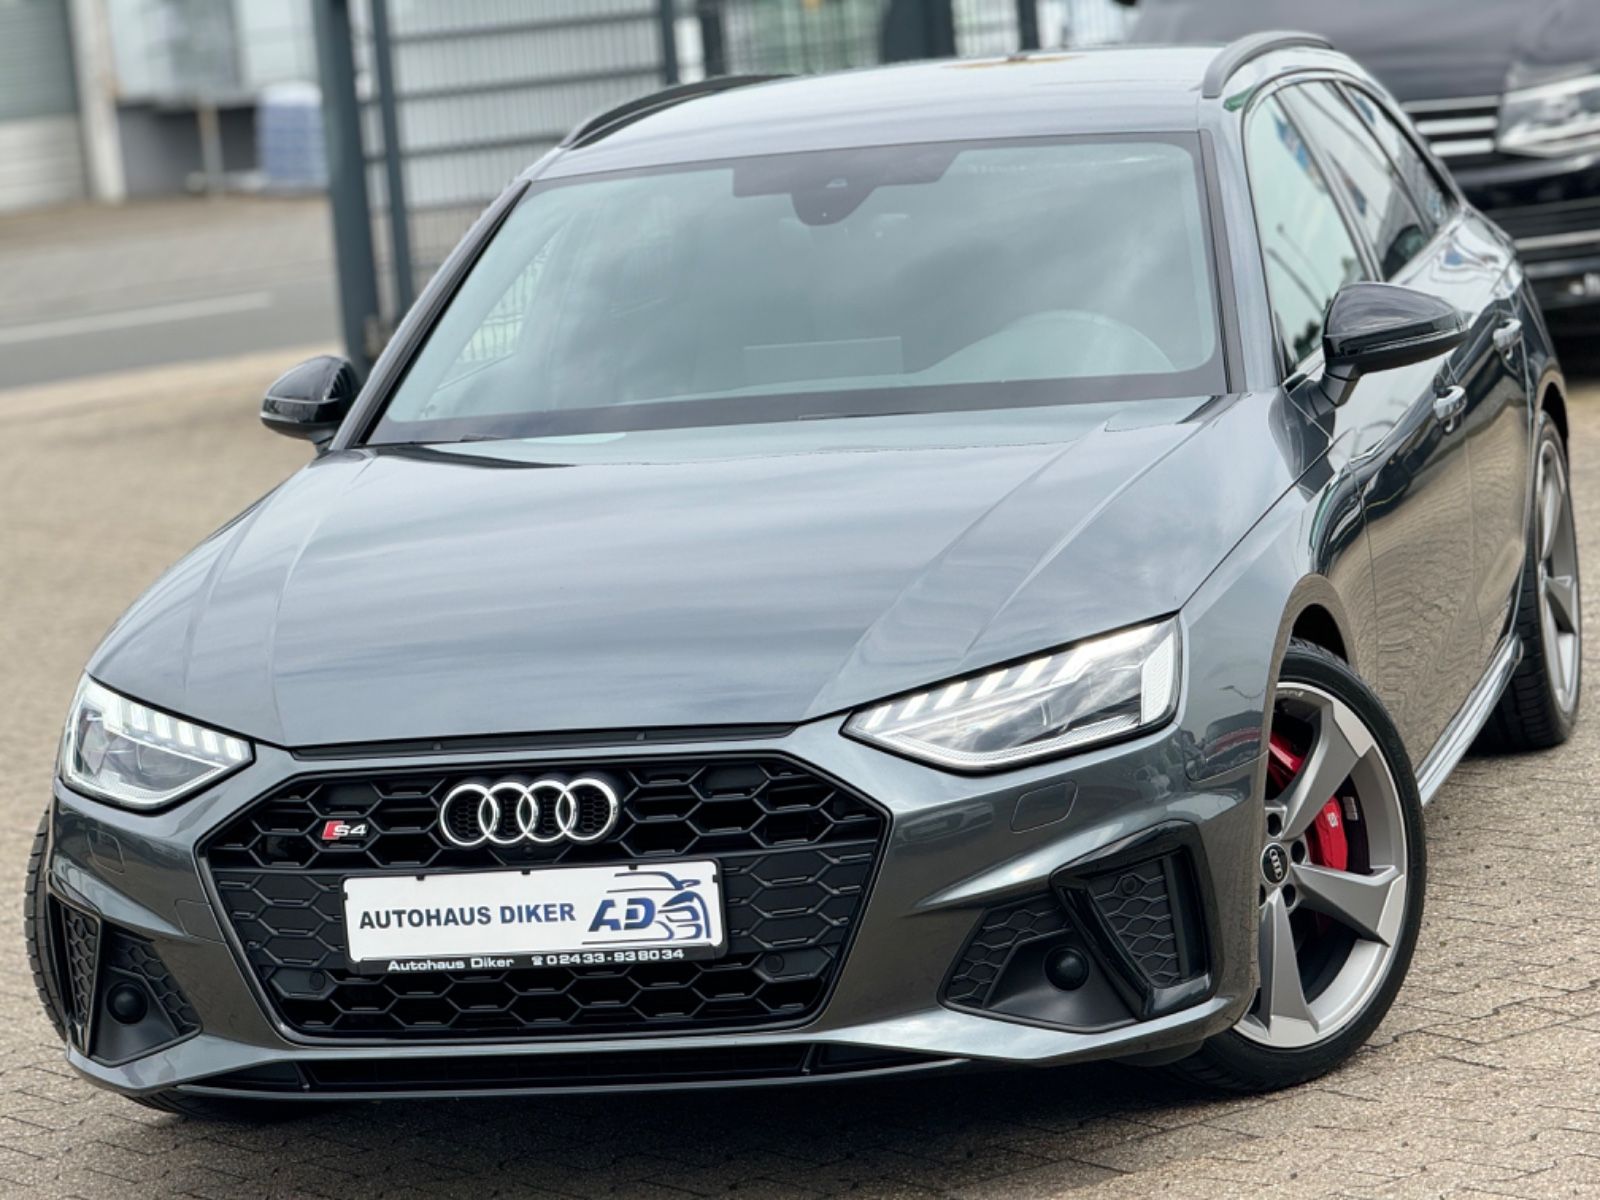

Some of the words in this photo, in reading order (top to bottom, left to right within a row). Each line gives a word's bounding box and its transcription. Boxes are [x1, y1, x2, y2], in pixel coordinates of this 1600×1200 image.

[332, 823, 367, 837] S4
[359, 906, 492, 930] AUTOHAUS
[500, 902, 576, 924] DIKER
[588, 897, 656, 932] AD
[387, 959, 465, 972] Autohaus
[470, 957, 514, 969] Diker
[546, 949, 684, 966] 02433-938034
